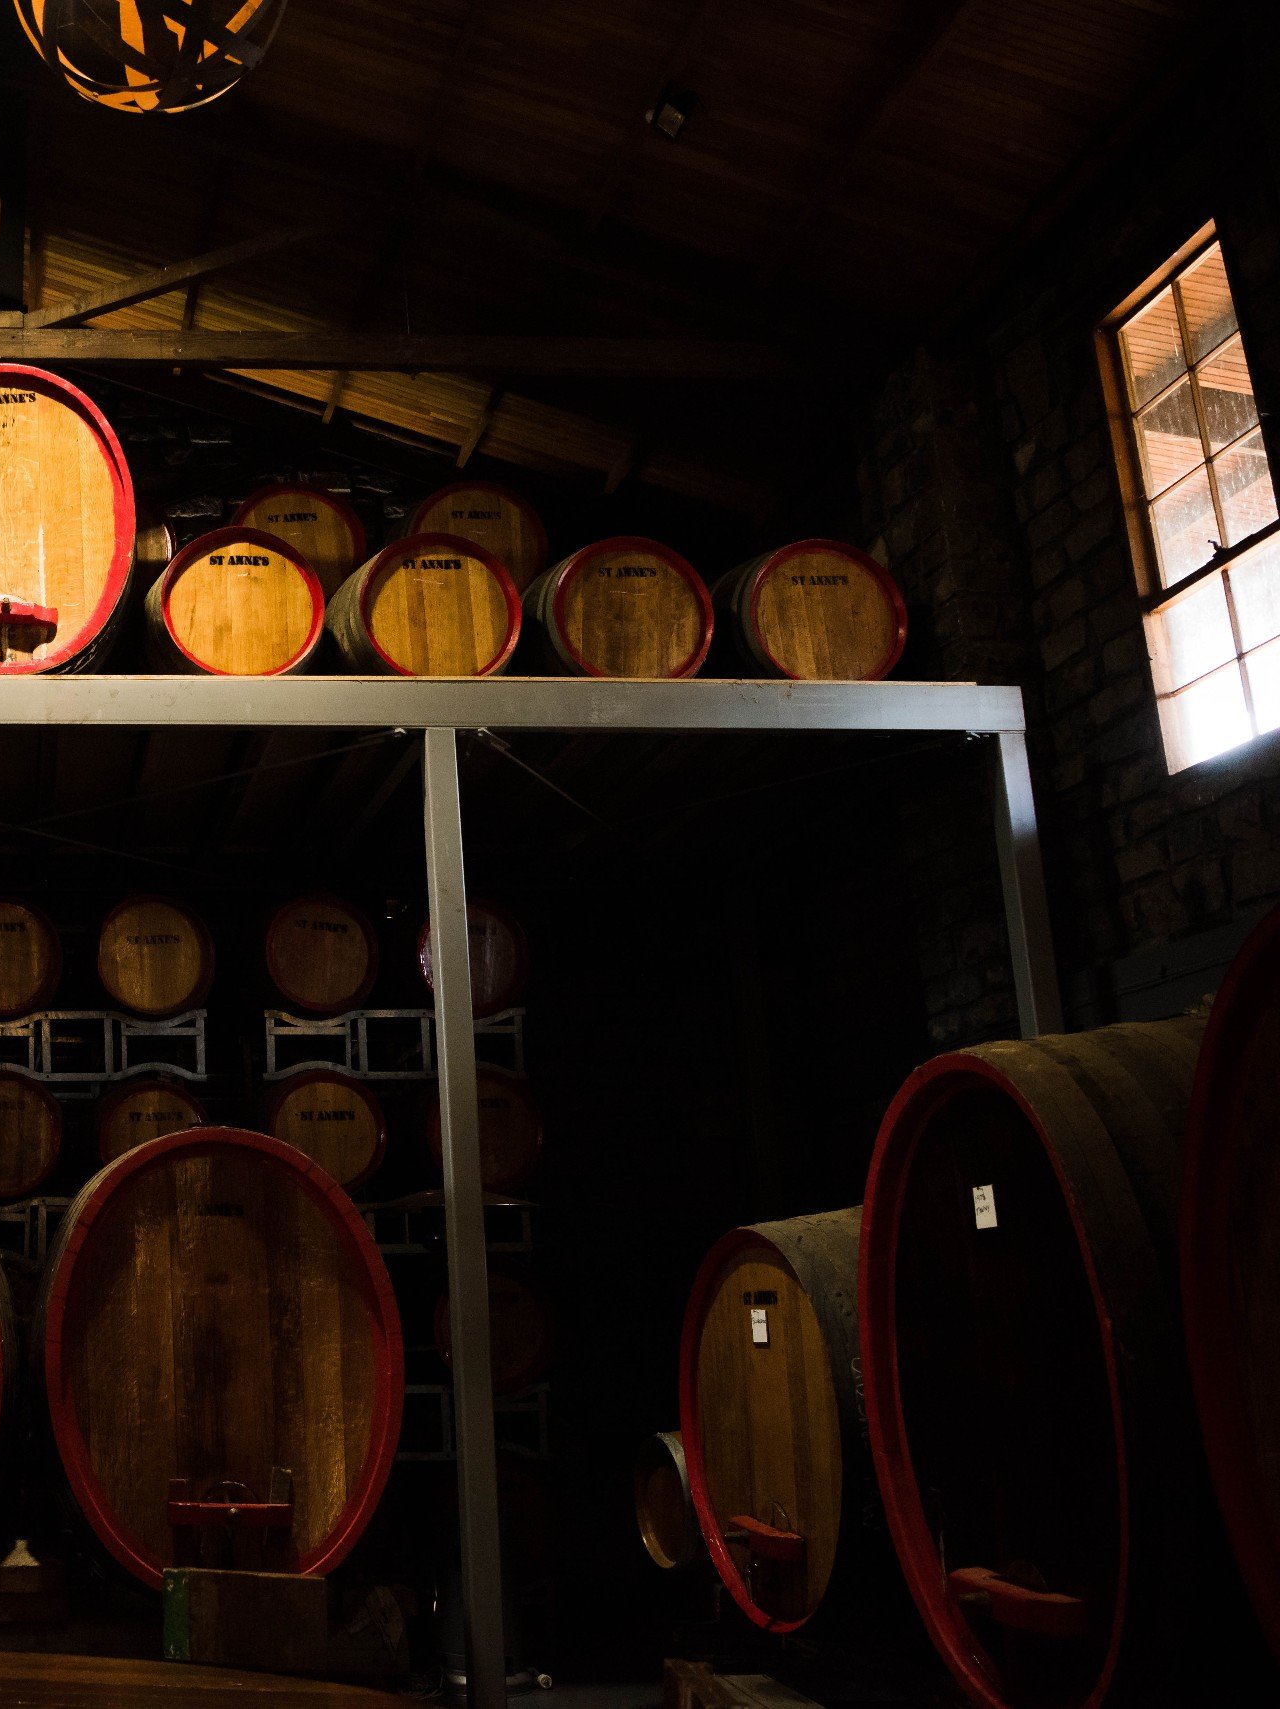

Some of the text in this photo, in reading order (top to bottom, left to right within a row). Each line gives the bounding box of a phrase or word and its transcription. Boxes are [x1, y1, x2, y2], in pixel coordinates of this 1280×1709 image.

[267, 512, 317, 523] ST ANNE'S
[451, 510, 501, 520] ST ANNE'S
[209, 555, 269, 567] ST ANNE'S
[402, 559, 461, 570] ST ANNE'S
[598, 567, 656, 578] ST ANNE'S
[791, 575, 848, 586] ST ANNE'S
